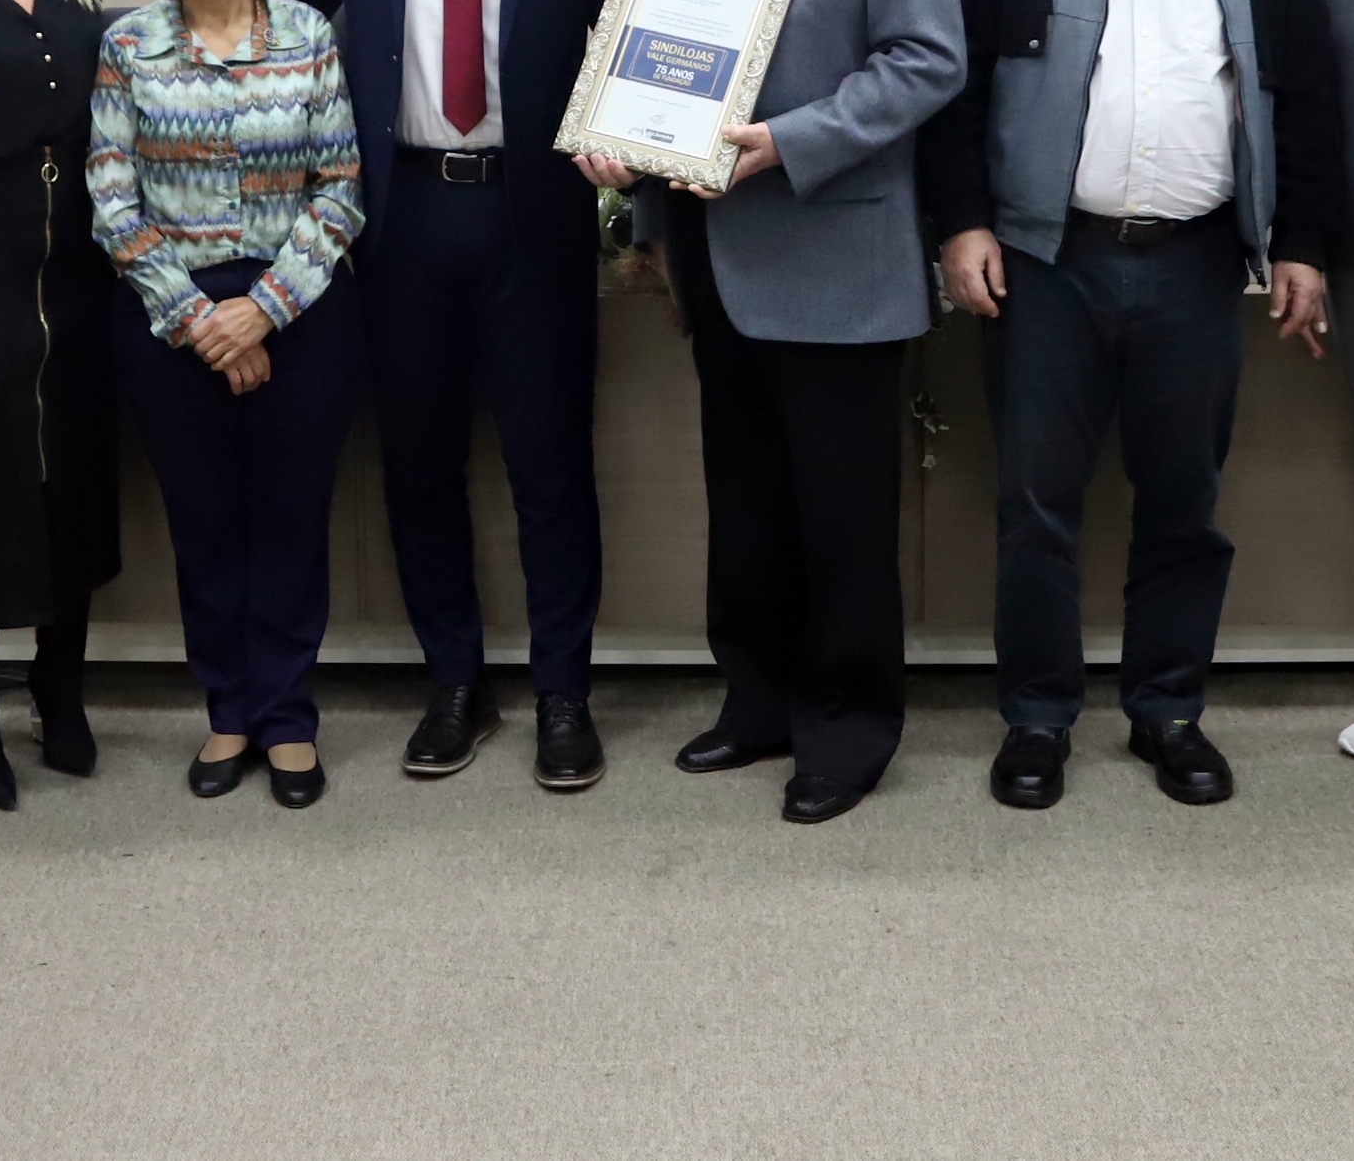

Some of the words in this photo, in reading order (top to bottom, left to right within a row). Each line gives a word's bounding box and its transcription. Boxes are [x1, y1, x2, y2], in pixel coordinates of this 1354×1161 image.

[646, 51, 666, 62] VALE
[649, 39, 716, 63] SINDILOJAS
[655, 63, 669, 75] 75
[668, 67, 695, 81] ANOS
